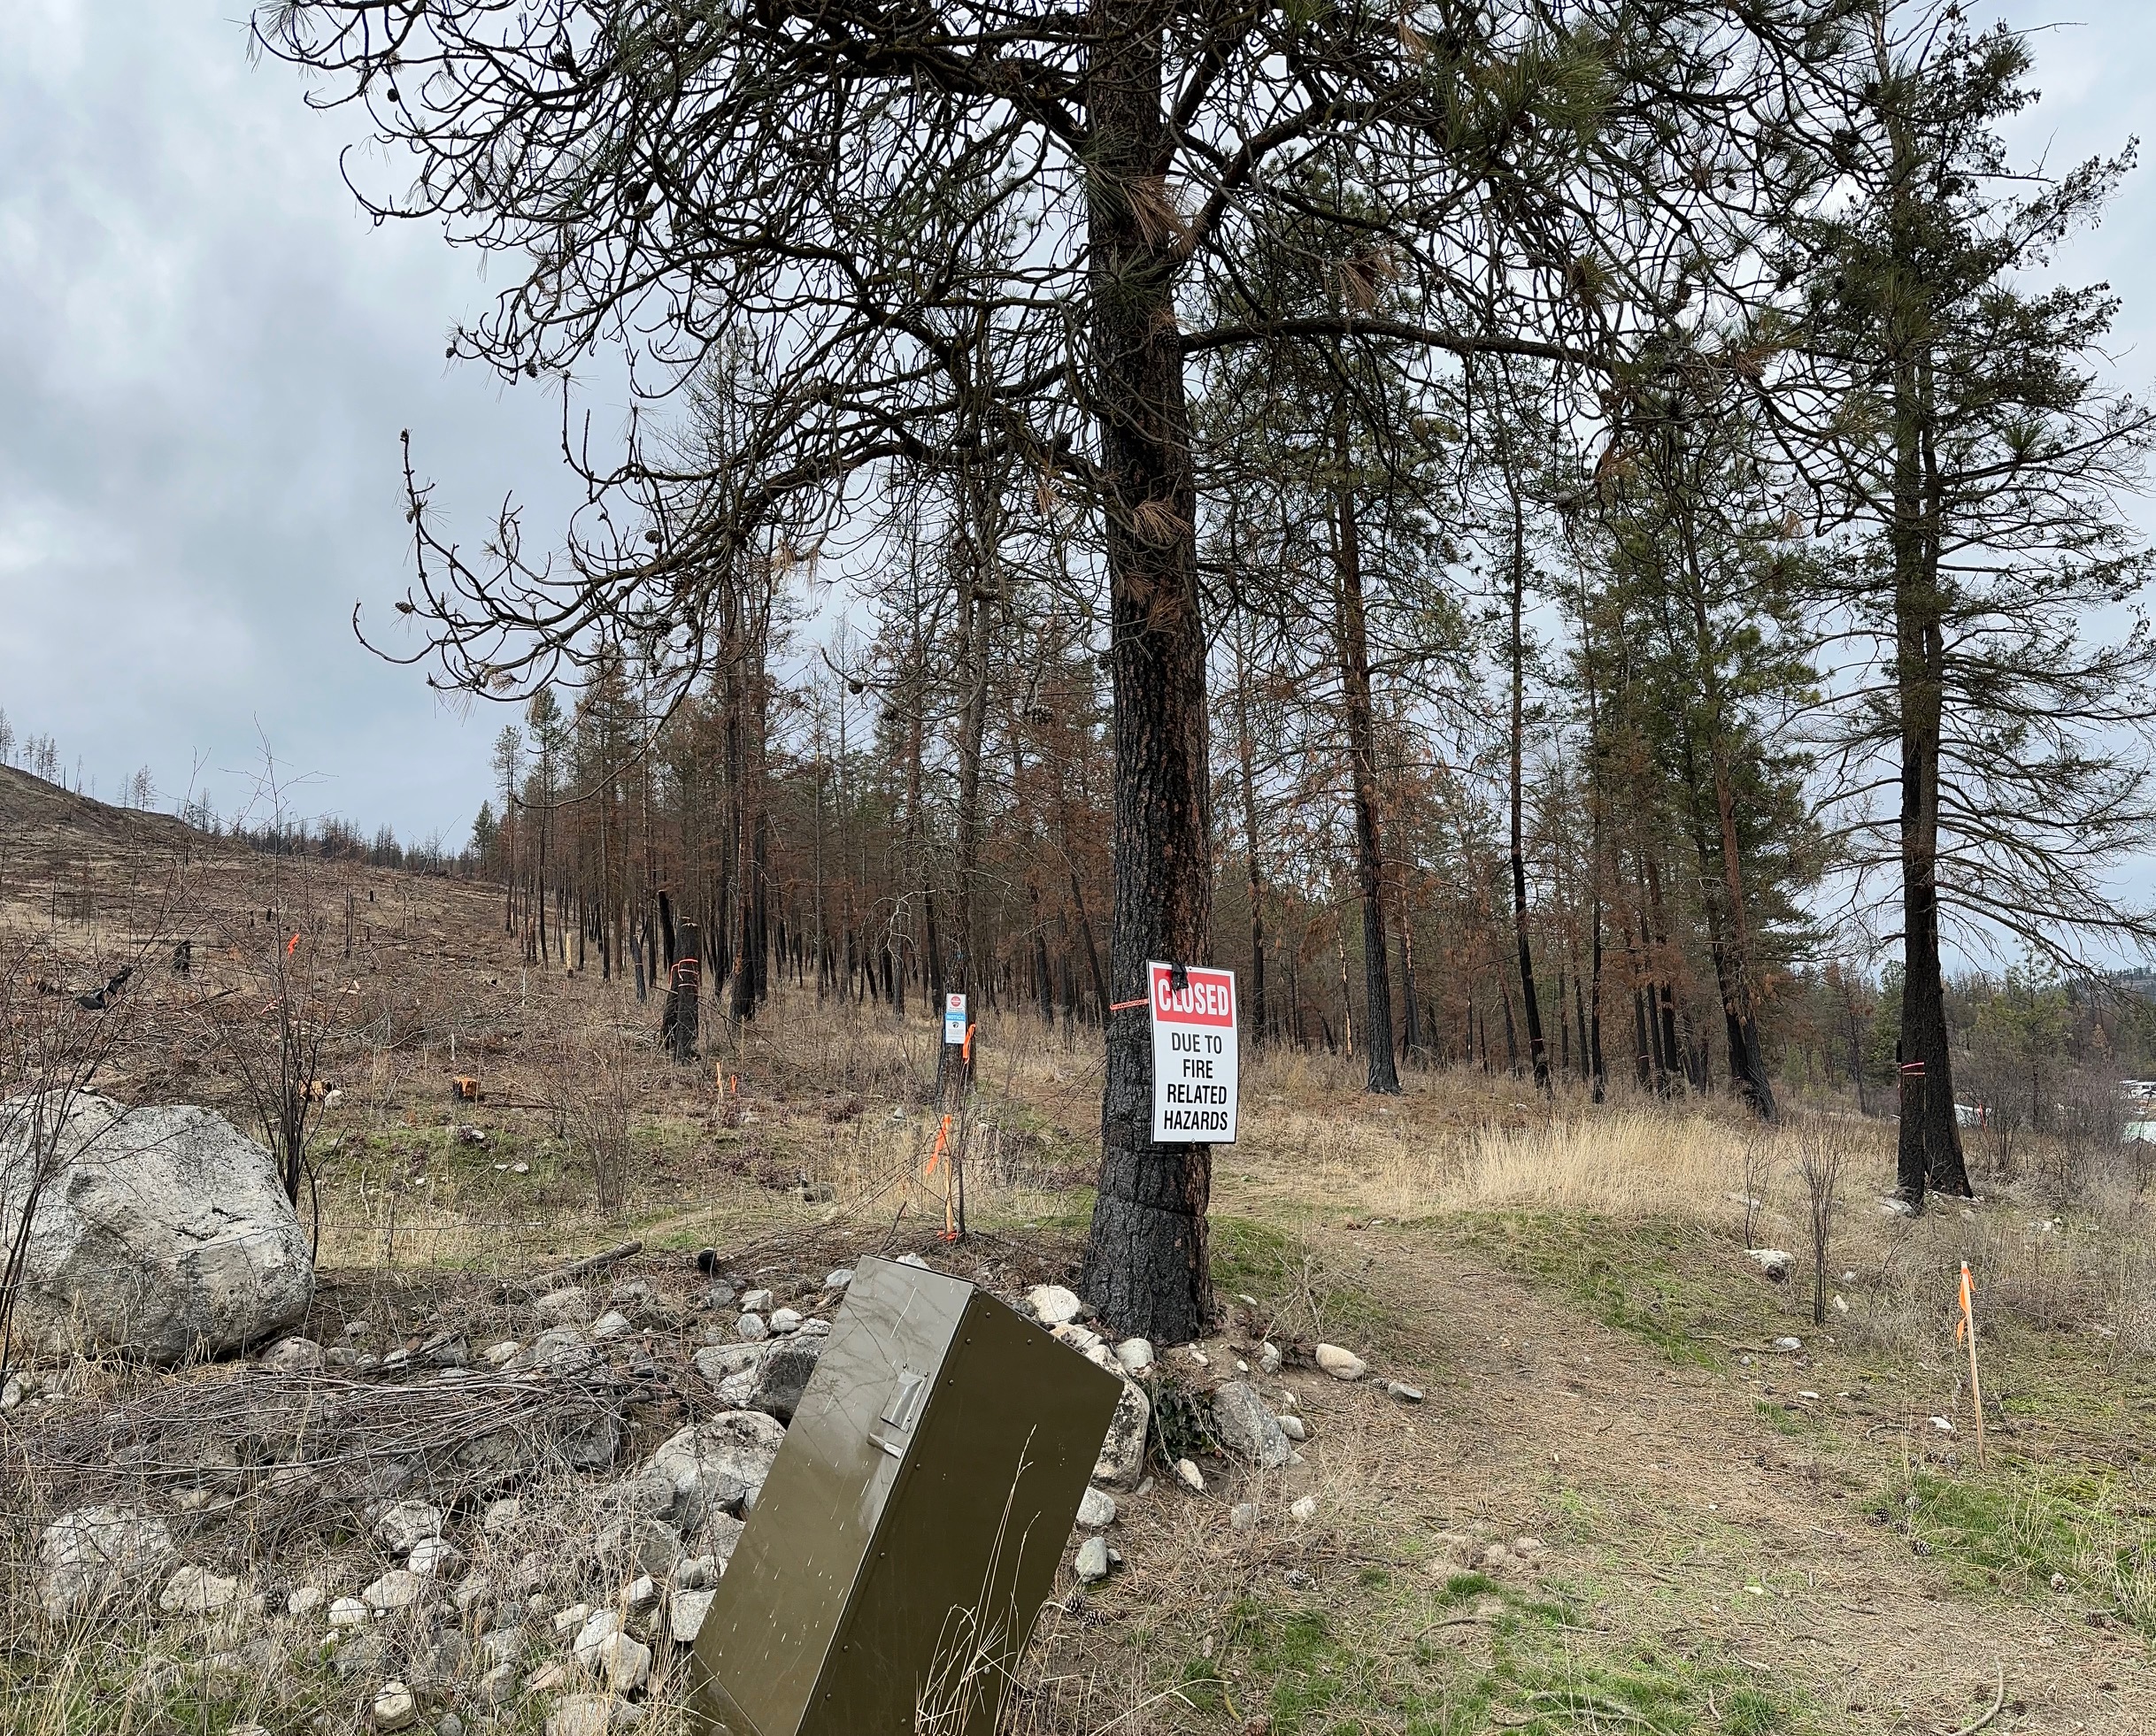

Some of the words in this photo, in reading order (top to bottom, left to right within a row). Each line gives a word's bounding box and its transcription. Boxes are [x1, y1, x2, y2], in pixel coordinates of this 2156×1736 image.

[1158, 978, 1229, 1016] CLOSED
[1171, 1032, 1201, 1053] DUE
[1205, 1034, 1222, 1054] TO
[1182, 1059, 1213, 1079] FIRE
[1167, 1083, 1228, 1105] RELATED
[1164, 1110, 1228, 1131] HAZARDS
